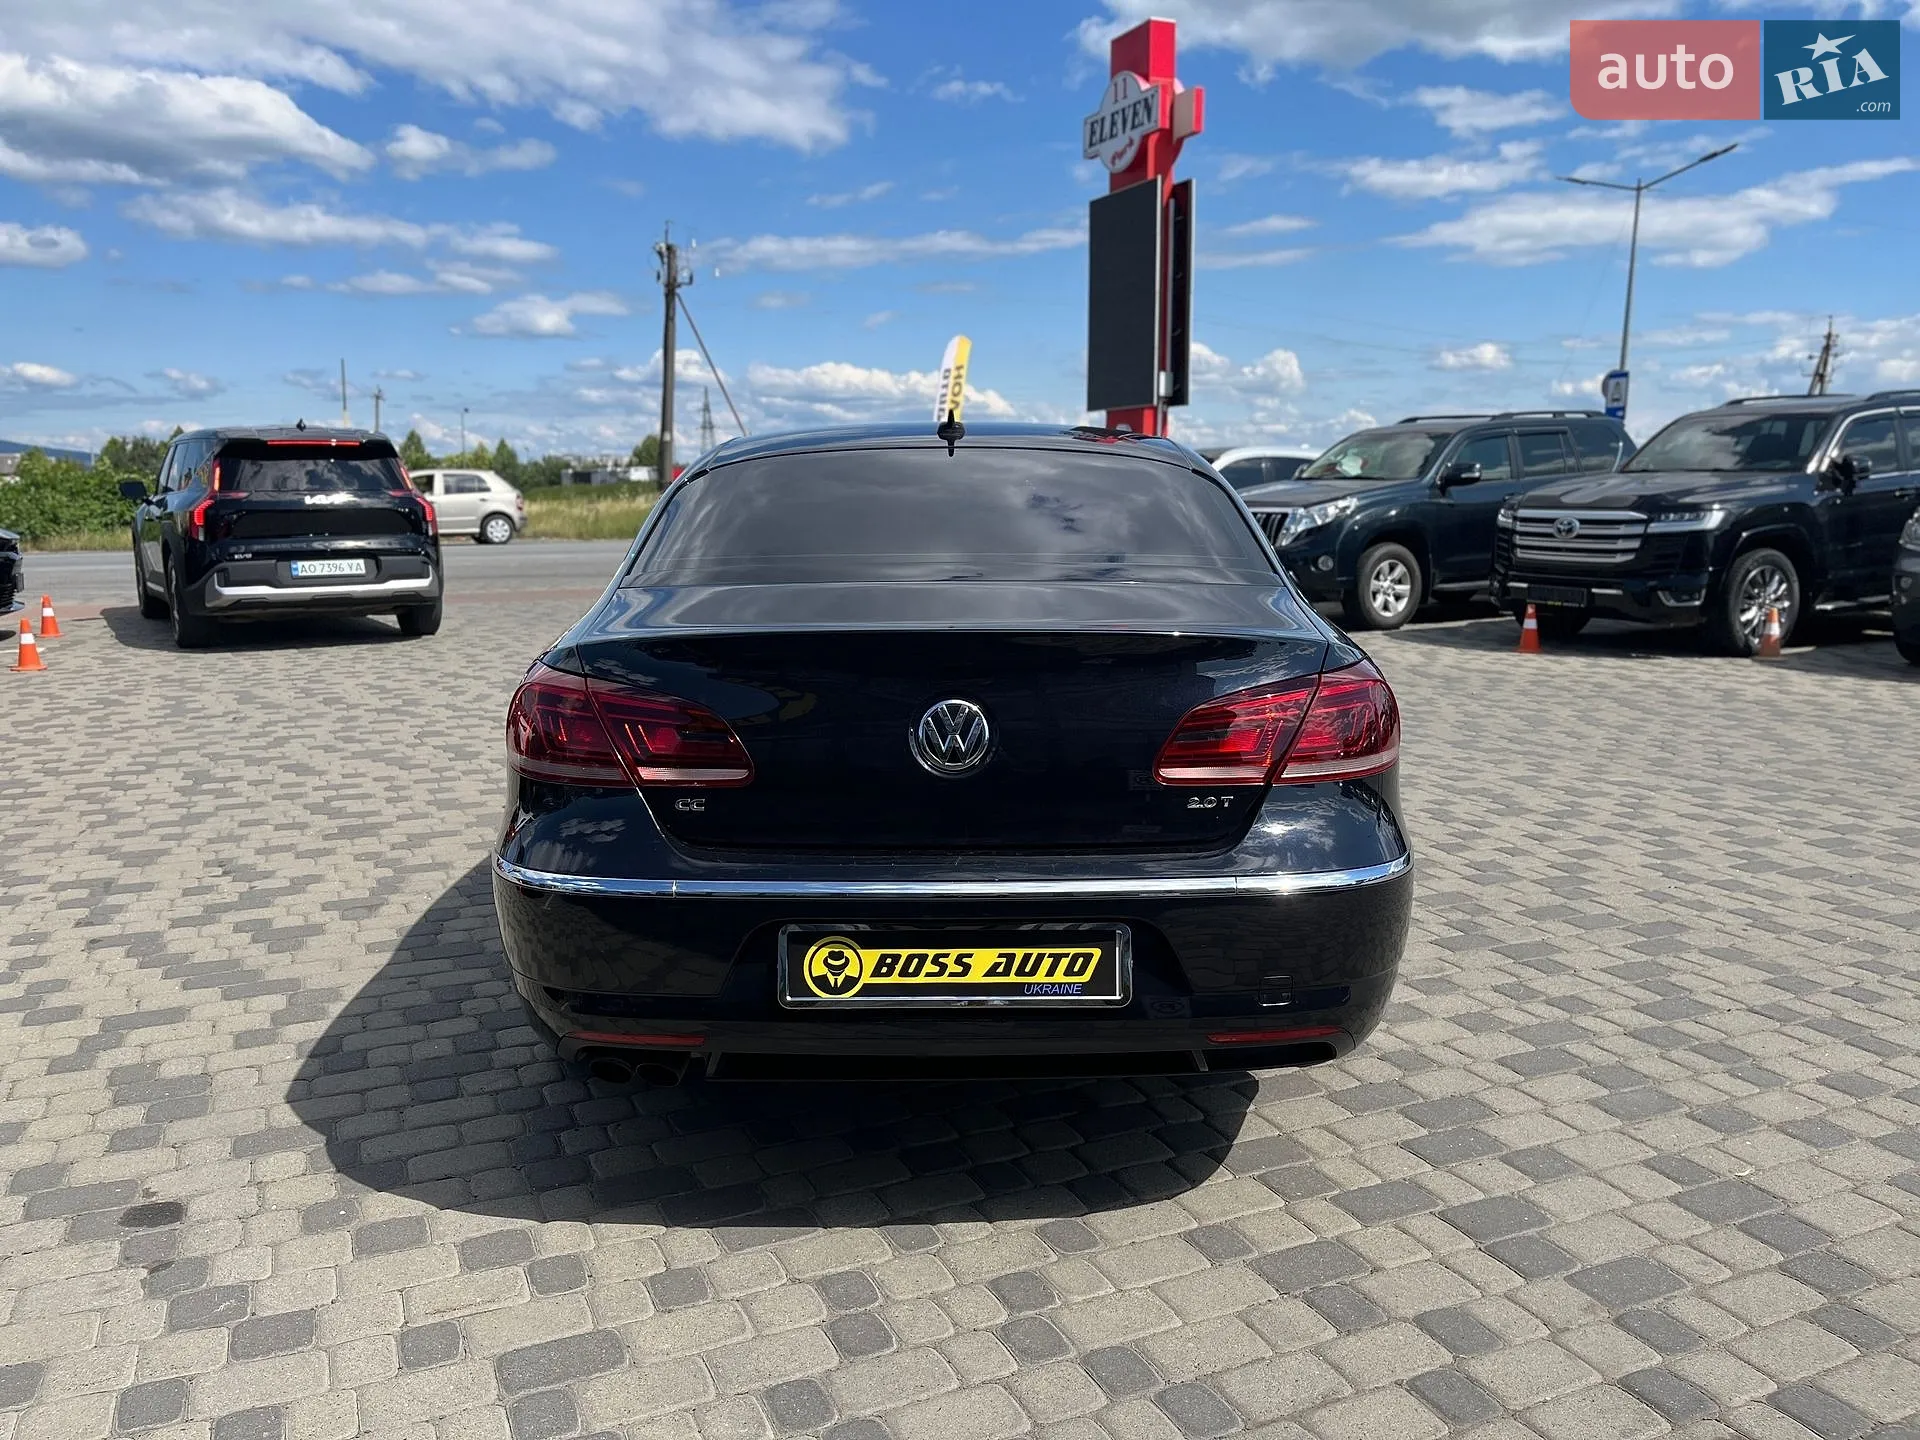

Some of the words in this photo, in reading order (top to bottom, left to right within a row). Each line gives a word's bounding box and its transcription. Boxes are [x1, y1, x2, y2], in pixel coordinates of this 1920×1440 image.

[1112, 78, 1128, 105] 11
[1088, 94, 1155, 148] ELEVEN
[319, 563, 345, 573] 7396
[674, 798, 706, 811] CC
[870, 952, 974, 978] BOSS
[981, 952, 1095, 978] AUTO
[1024, 983, 1083, 995] UKRAINE
